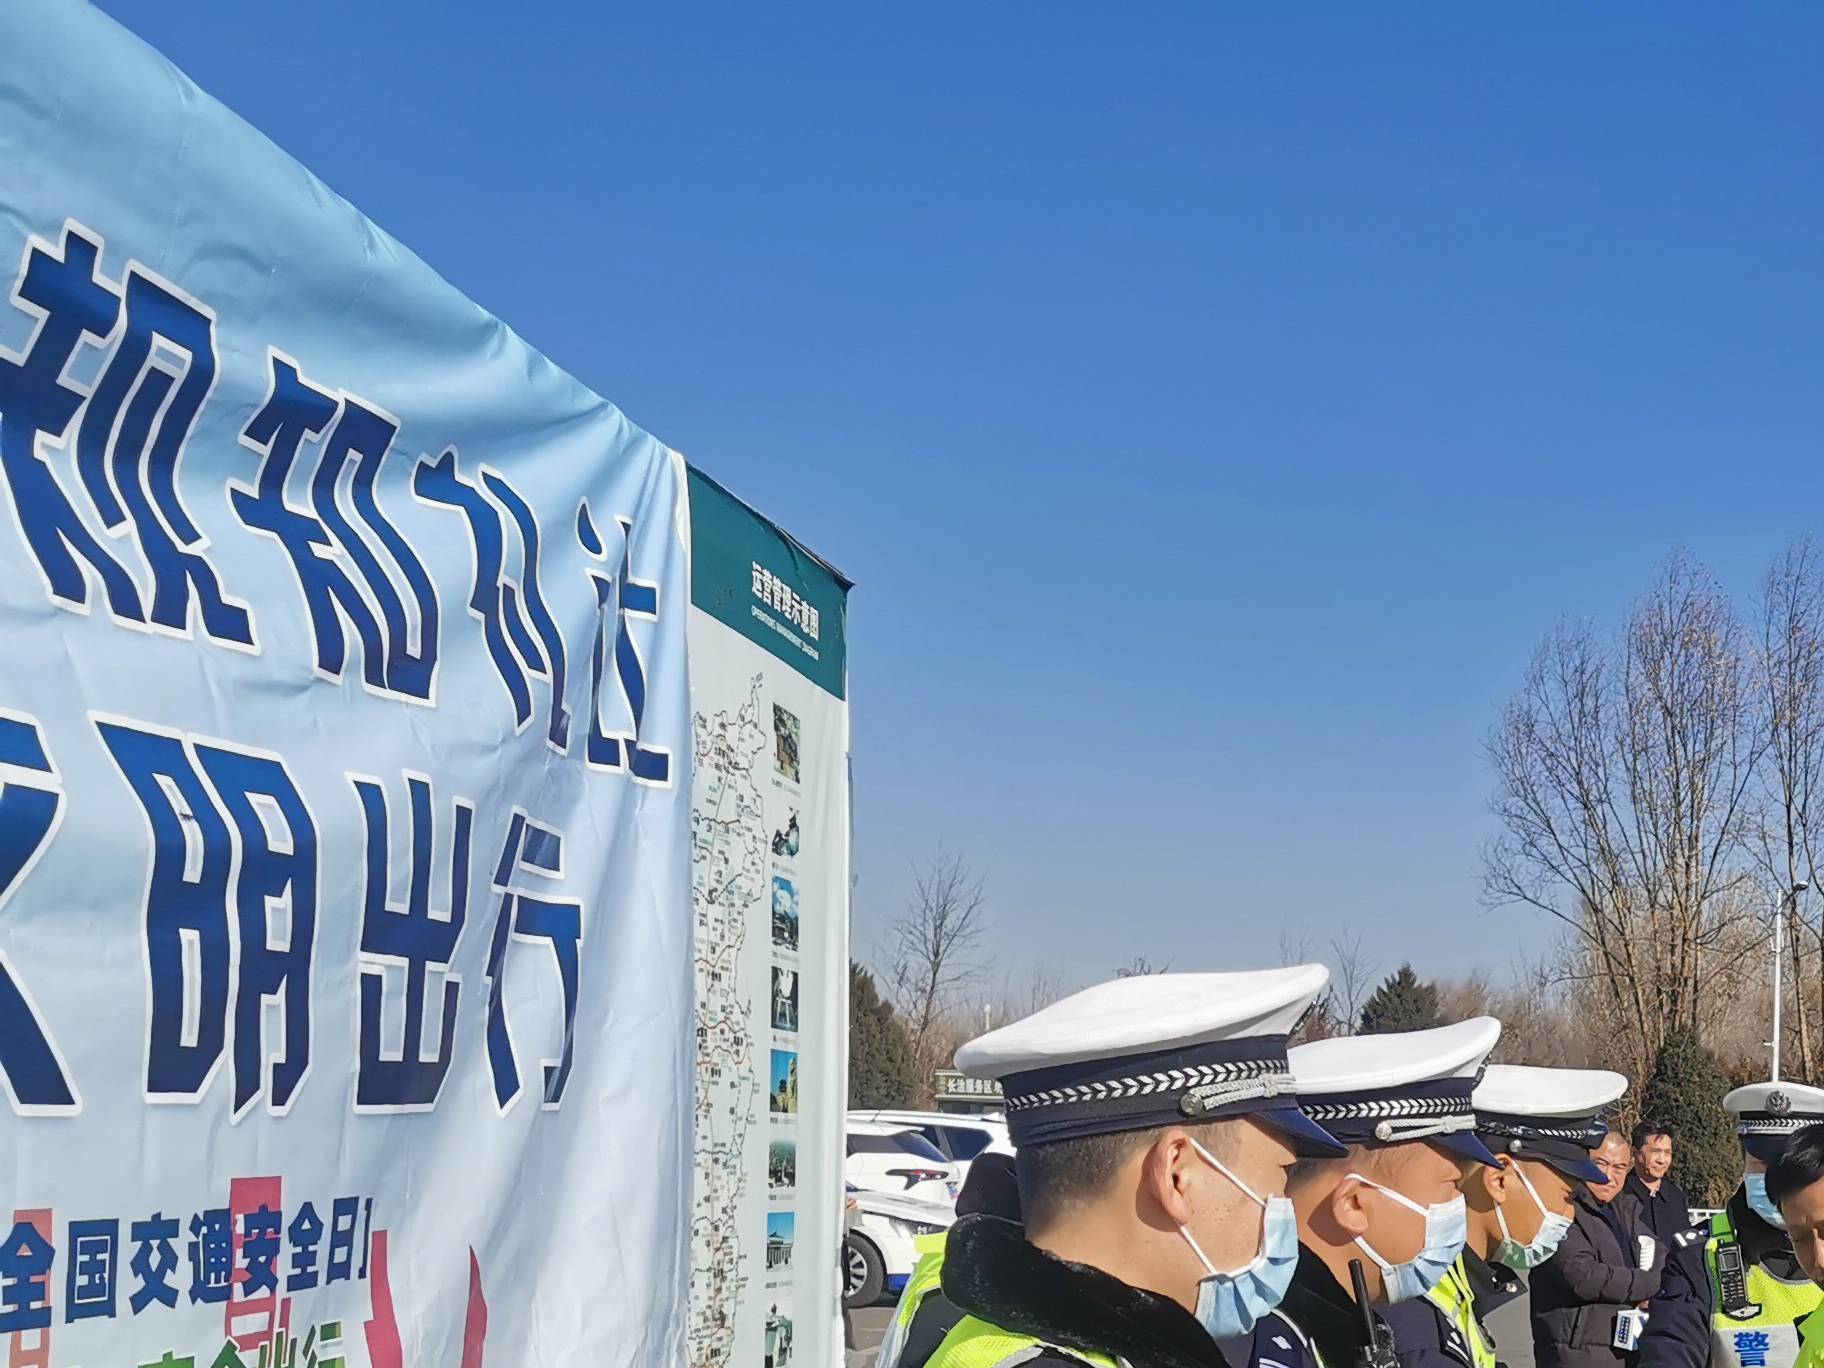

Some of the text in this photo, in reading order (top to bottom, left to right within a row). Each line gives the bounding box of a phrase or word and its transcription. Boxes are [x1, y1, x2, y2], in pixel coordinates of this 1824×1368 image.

[752, 560, 819, 641] 运营管理示意图
[1733, 1330, 1770, 1368] 警
